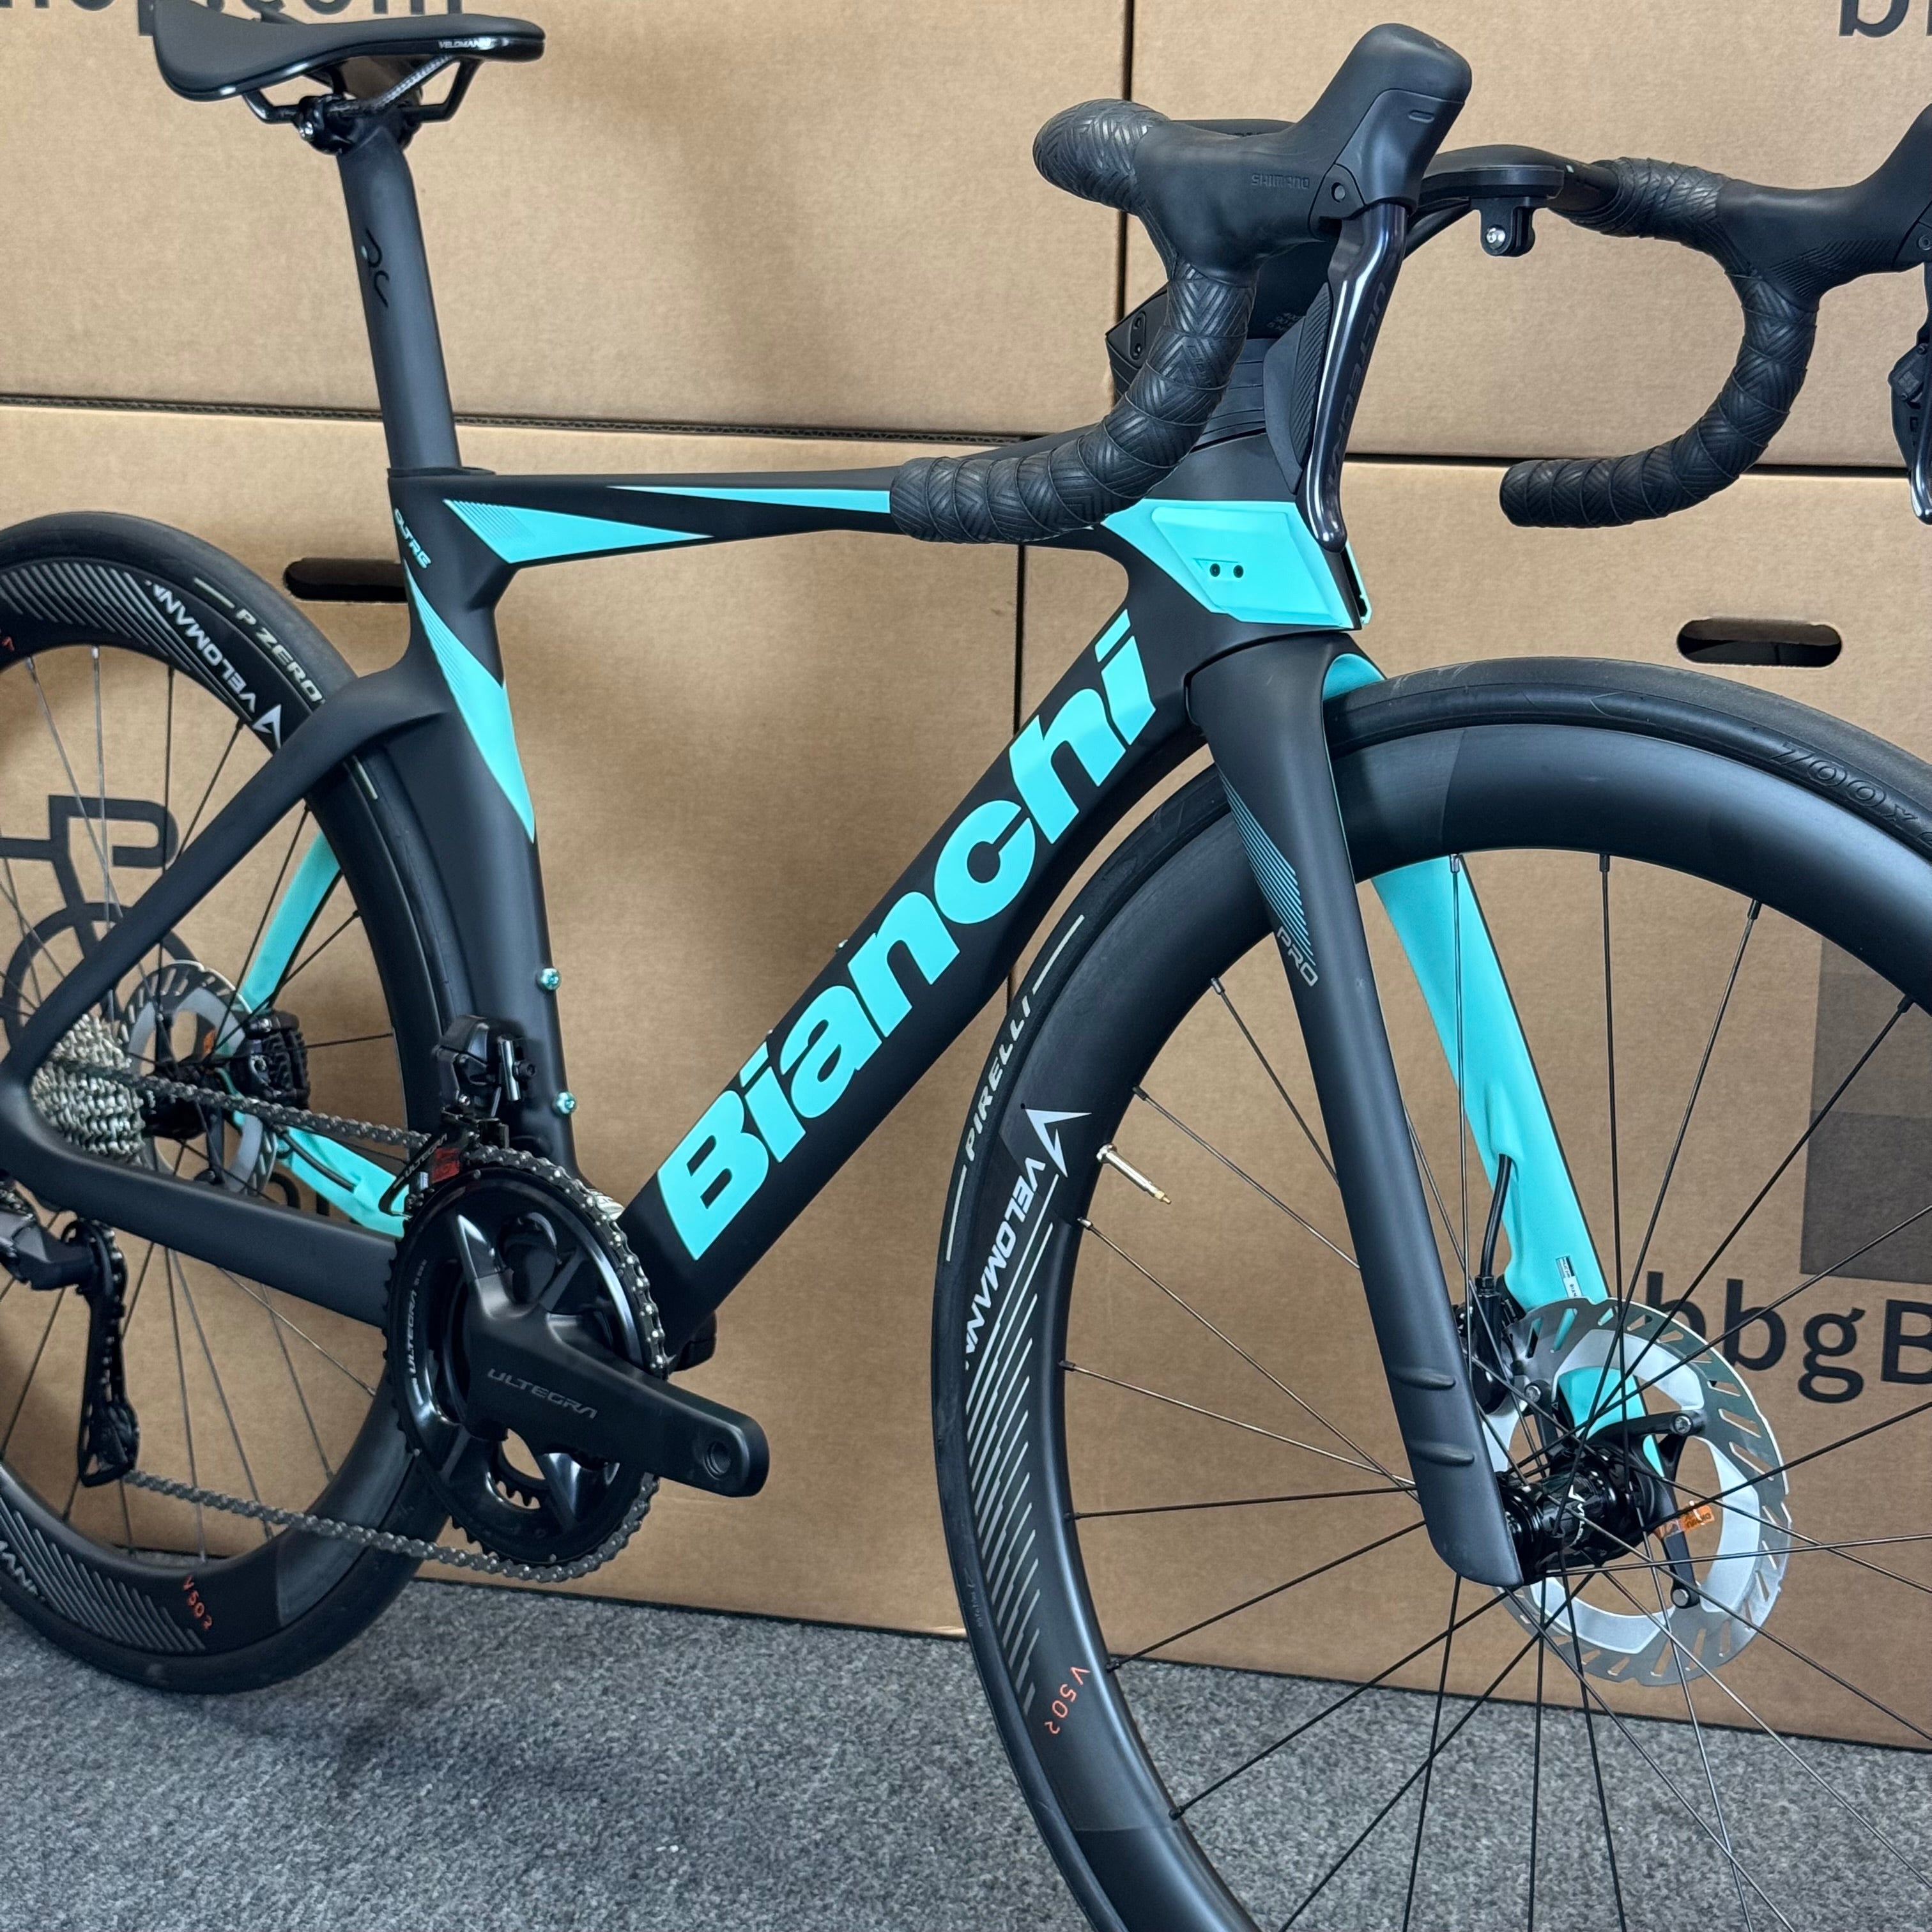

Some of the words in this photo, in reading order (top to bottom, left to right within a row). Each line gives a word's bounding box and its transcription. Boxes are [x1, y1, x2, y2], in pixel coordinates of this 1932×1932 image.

[1252, 171, 1309, 190] SHIMANO
[236, 609, 256, 625] P
[256, 627, 323, 702] ZERO
[657, 608, 1156, 1261] Bianchi
[1277, 926, 1319, 987] PRO
[965, 995, 1031, 1162] PIRELLI
[487, 1368, 598, 1420] ULTEGRA
